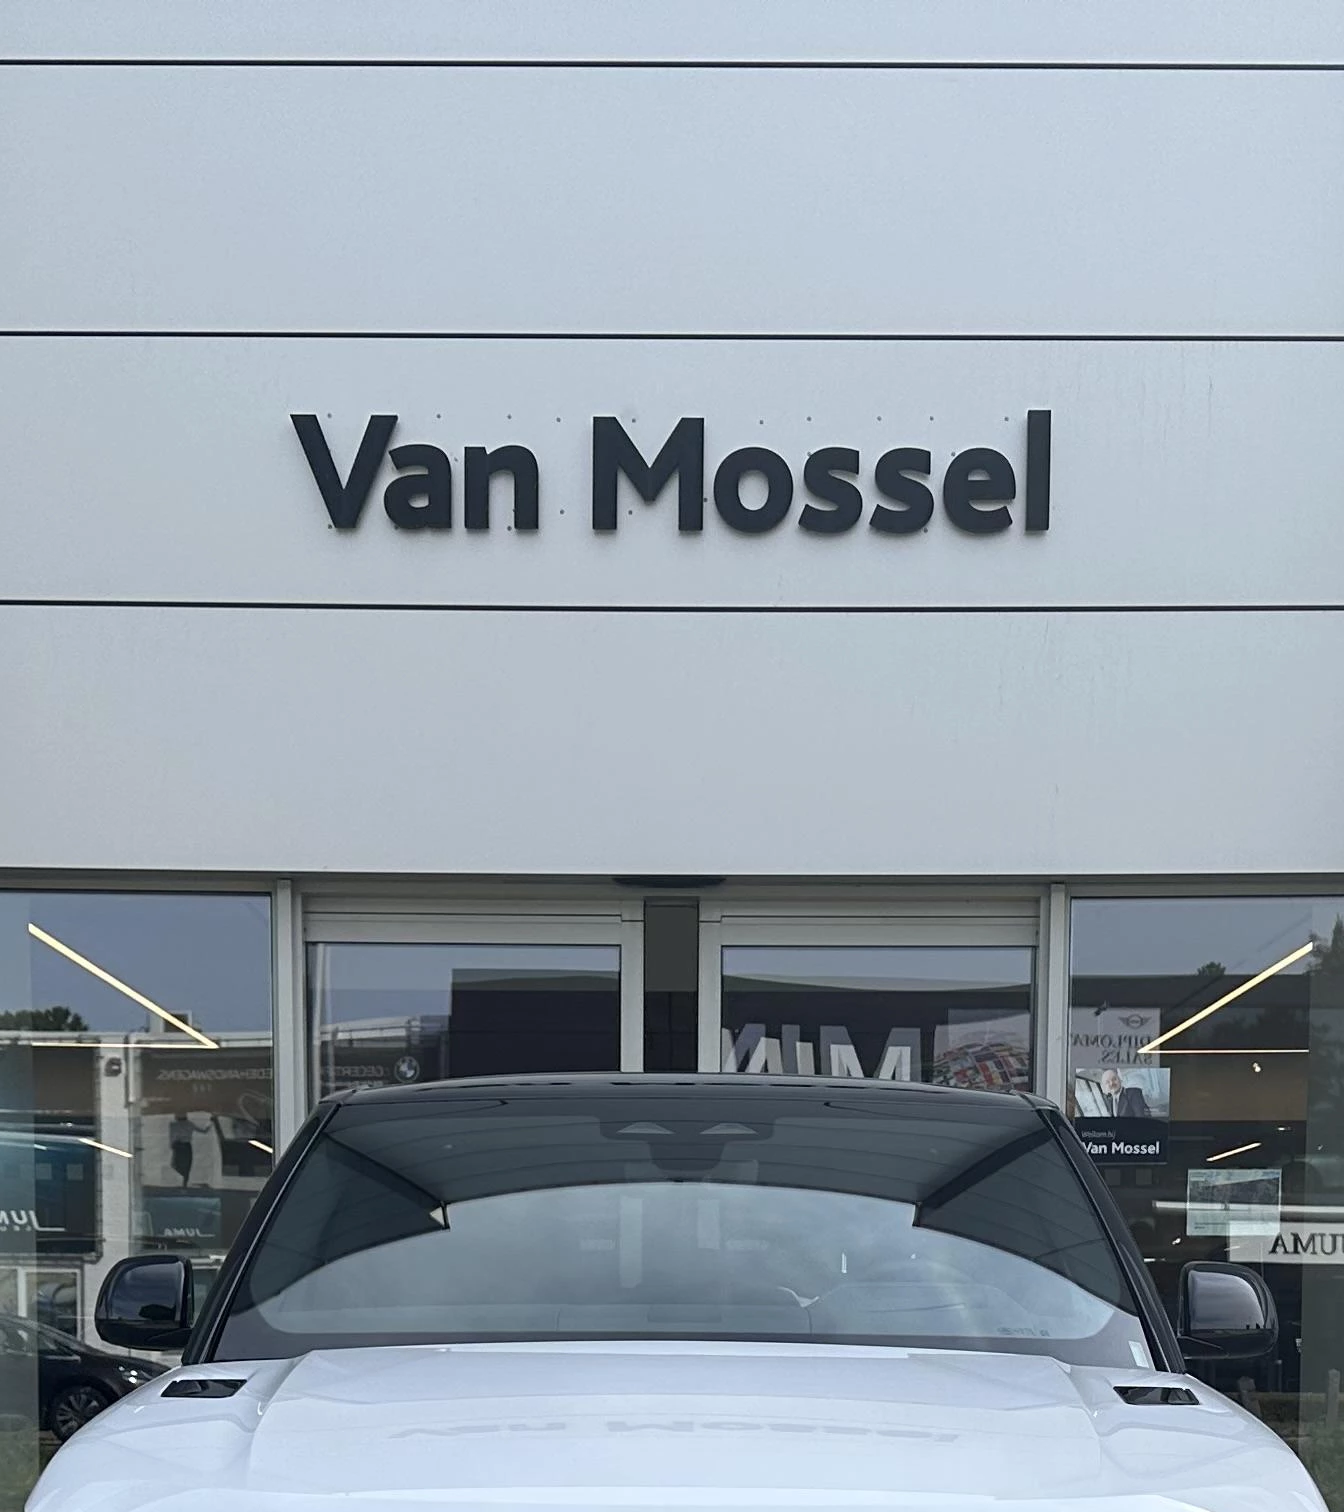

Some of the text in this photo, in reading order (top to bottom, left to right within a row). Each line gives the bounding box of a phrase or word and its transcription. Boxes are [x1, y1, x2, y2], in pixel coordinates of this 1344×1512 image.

[290, 409, 1052, 536] Van Mossel
[1082, 1140, 1161, 1155] Van Mossel
